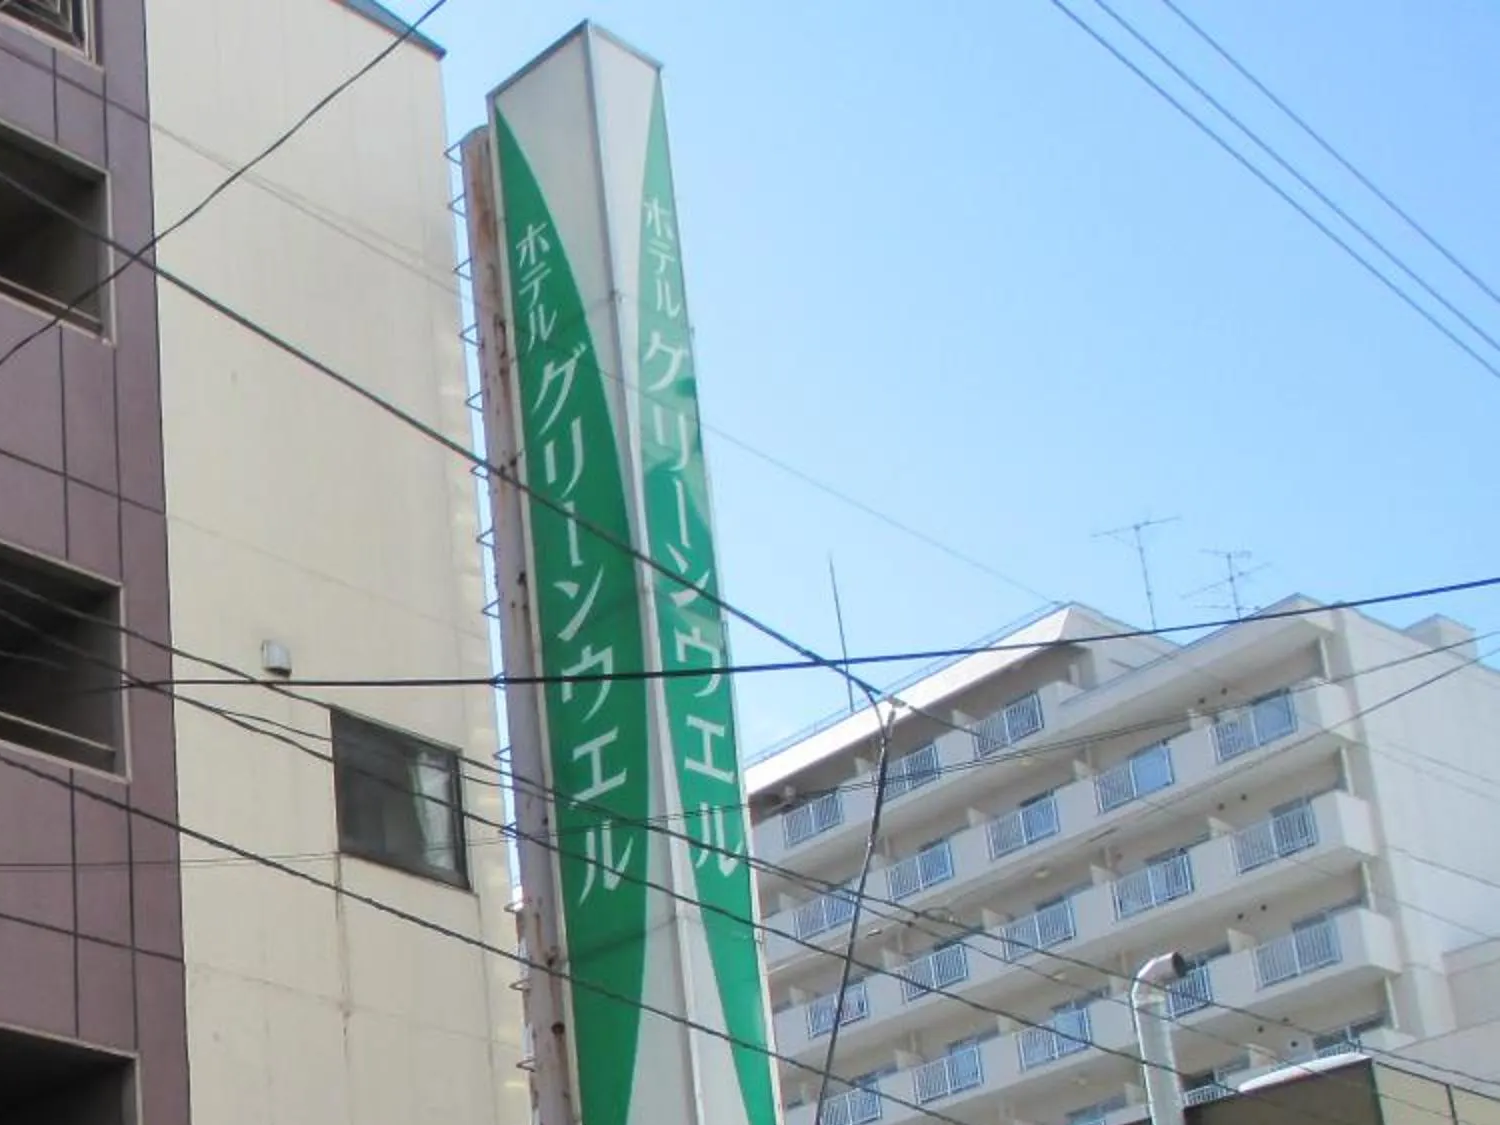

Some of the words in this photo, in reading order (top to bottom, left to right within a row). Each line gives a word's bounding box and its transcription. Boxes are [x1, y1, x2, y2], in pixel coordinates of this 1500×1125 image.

[514, 221, 634, 907] ホテルグリーンウエル
